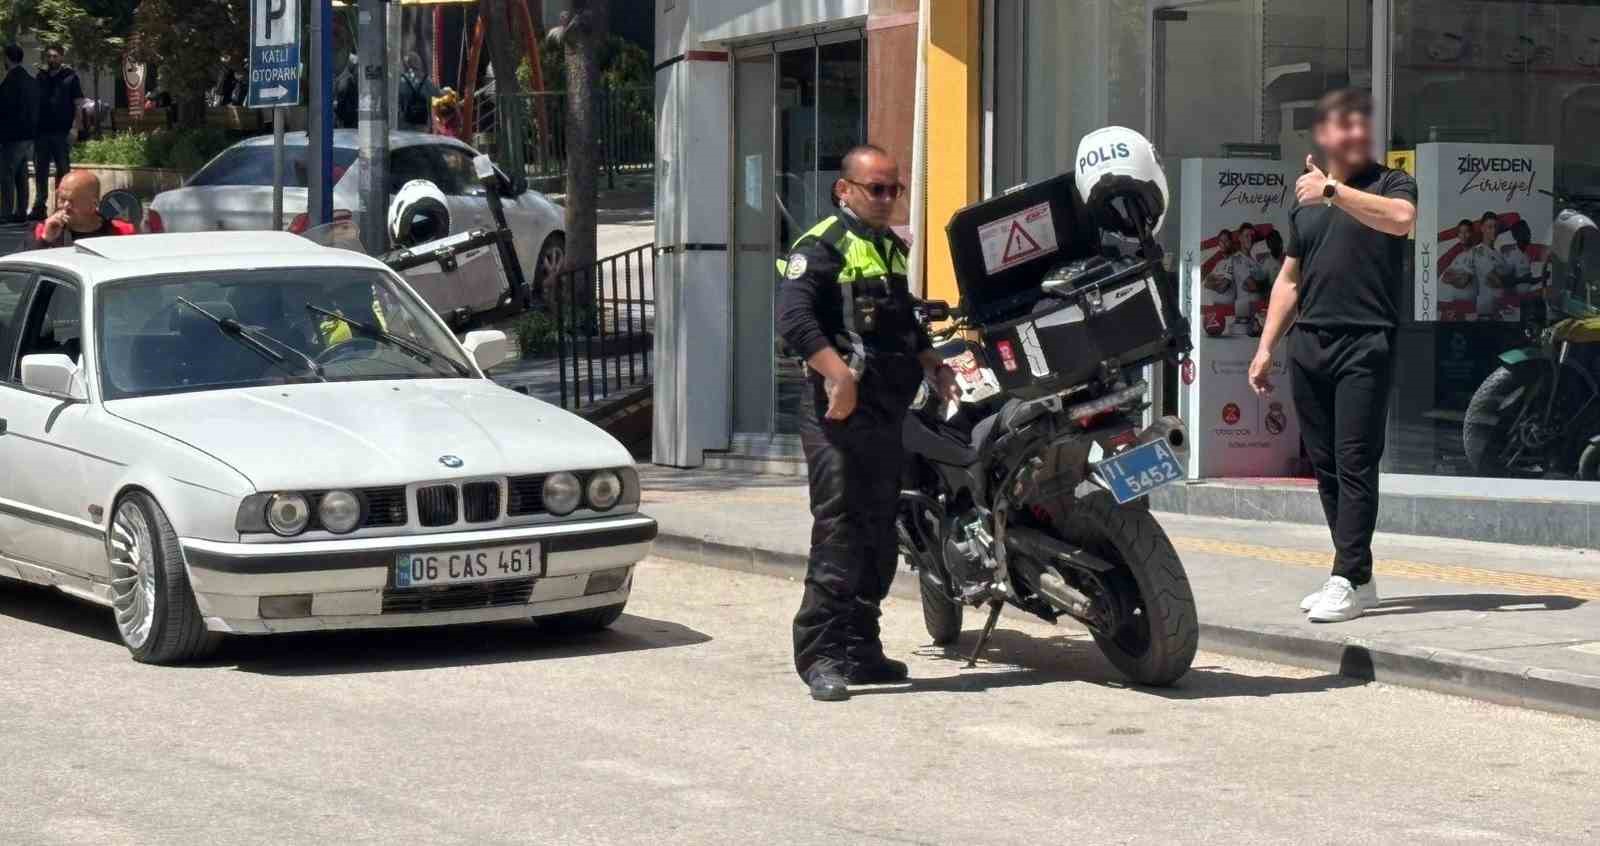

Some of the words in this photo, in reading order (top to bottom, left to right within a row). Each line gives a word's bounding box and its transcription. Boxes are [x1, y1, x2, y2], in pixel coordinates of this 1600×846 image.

[265, 0, 287, 39] P
[262, 49, 288, 62] KATLI
[252, 66, 297, 82] OTOPARK
[1457, 154, 1533, 174] ZİRVEDEN
[1218, 169, 1284, 187] ZİRVEDEN
[1154, 444, 1169, 461] A
[1125, 461, 1178, 493] 5452
[411, 556, 438, 581] 06
[449, 552, 488, 578] CAS
[498, 548, 532, 573] 461
